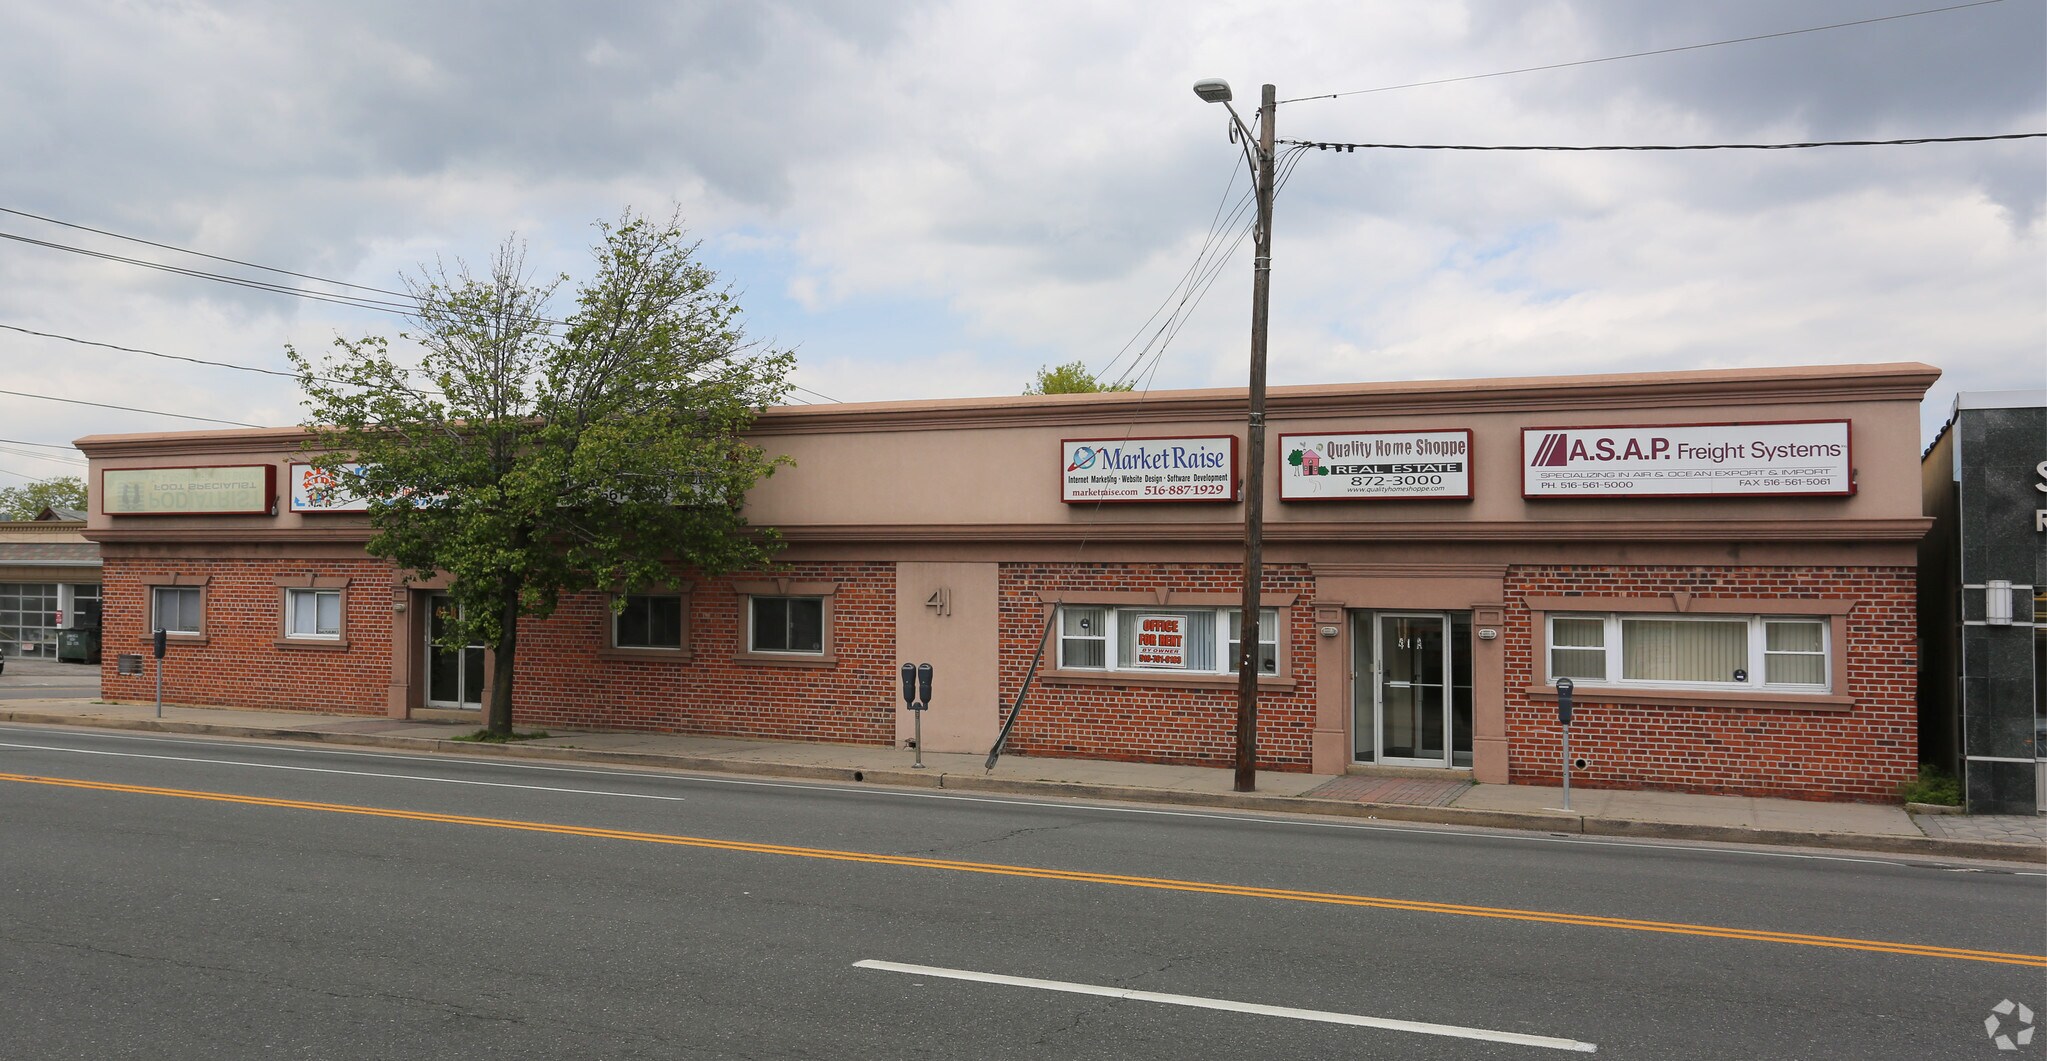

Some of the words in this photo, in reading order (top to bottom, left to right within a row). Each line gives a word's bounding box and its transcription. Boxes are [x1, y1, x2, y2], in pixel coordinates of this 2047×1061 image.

[1327, 440, 1371, 459] Quality
[1375, 439, 1412, 456] Home
[1416, 438, 1466, 457] Shoppe
[1569, 437, 1670, 461] A.S.A.P.
[1678, 442, 1745, 463] Freight
[1751, 441, 1841, 462] Systems
[1336, 465, 1383, 474] REAL
[1392, 463, 1457, 473] ESTATE
[1068, 475, 1089, 484] Internet
[1091, 475, 1117, 485] Marketing
[1122, 474, 1143, 483] Website
[1145, 474, 1163, 484] Design
[1166, 473, 1190, 483] Software
[1193, 473, 1228, 484] Development
[1351, 475, 1442, 486] 872-3000
[1560, 481, 1633, 489] 516-561-5000
[1763, 478, 1831, 486] 516-561-5061
[1072, 488, 1138, 497] marketraise.com
[1144, 485, 1224, 496] 516-887-1929
[1347, 485, 1445, 493] www.qualityhomeshoppe.com
[925, 588, 951, 617] 41
[1143, 619, 1179, 632] OFFICE
[1139, 634, 1156, 646] FOR
[1159, 634, 1182, 647] RENT
